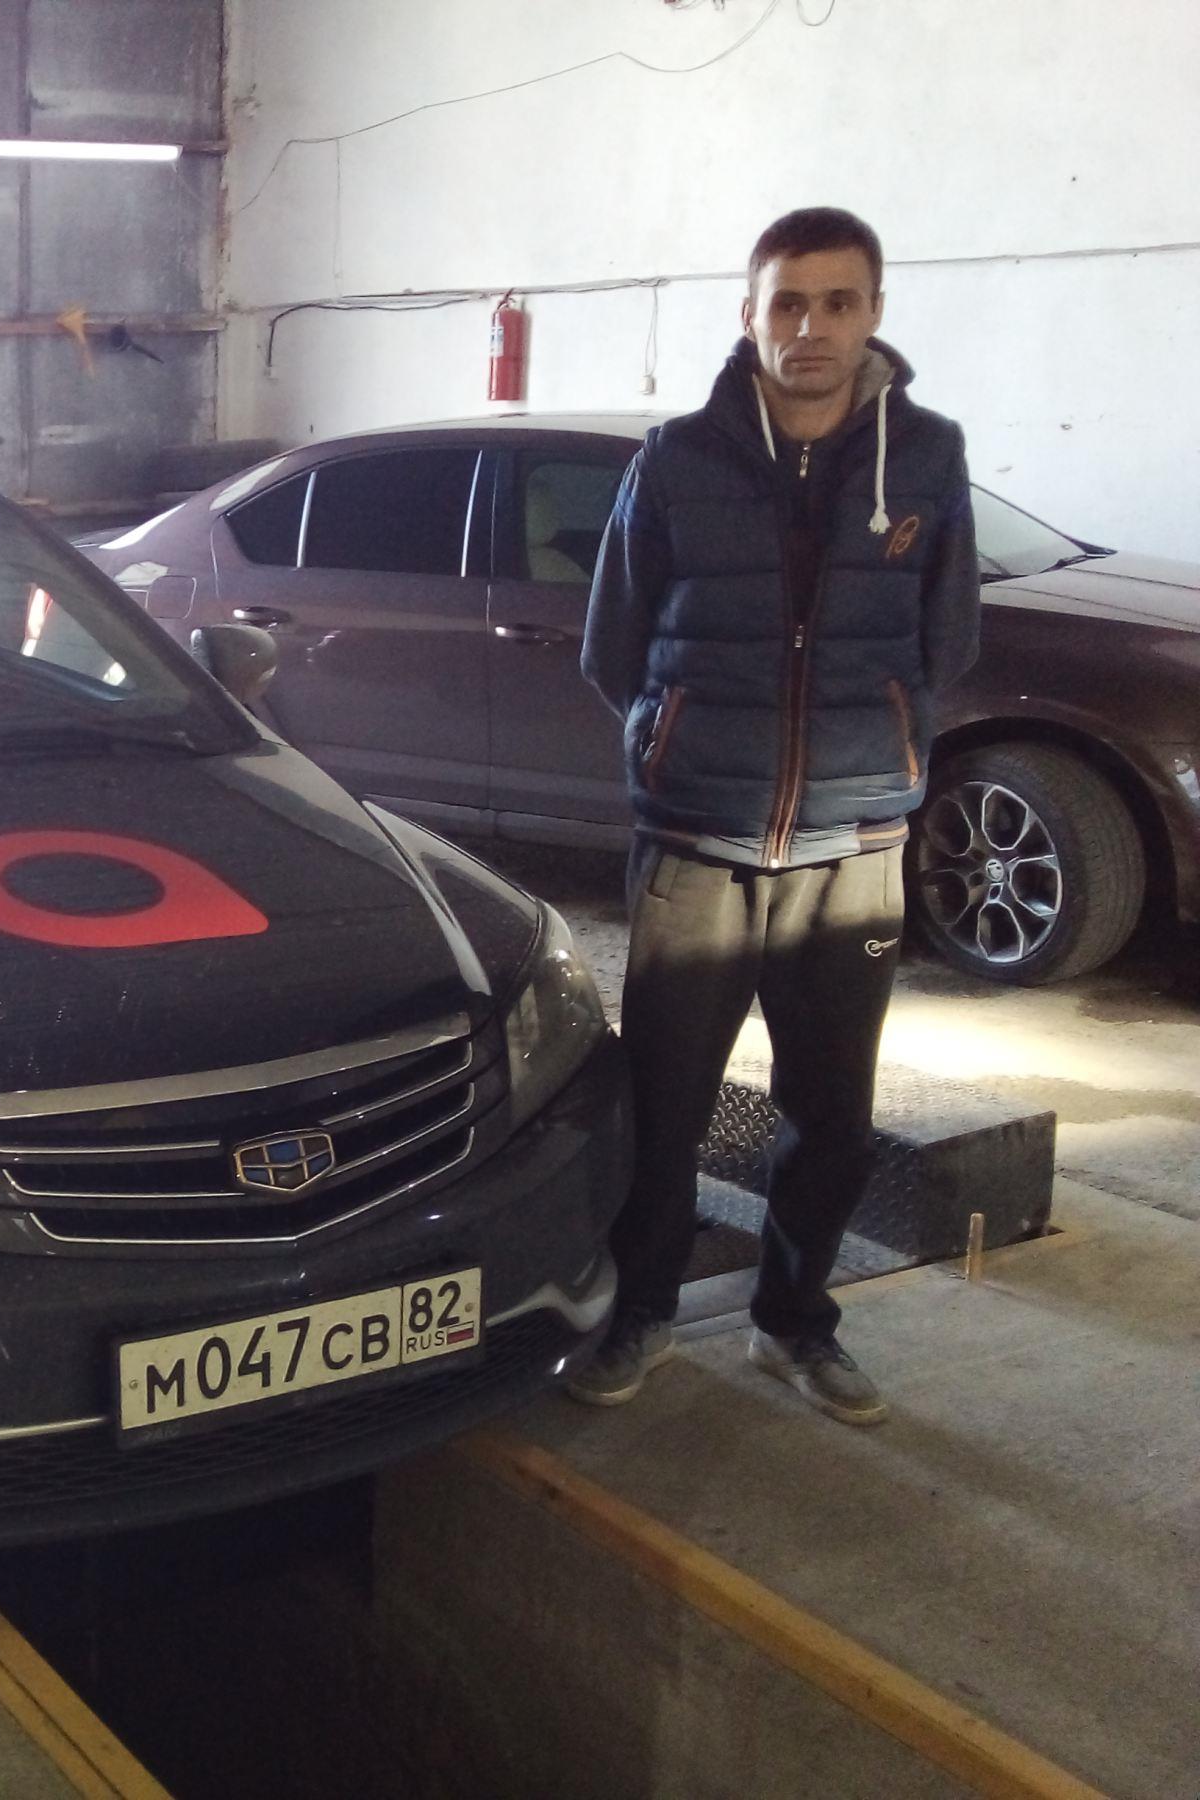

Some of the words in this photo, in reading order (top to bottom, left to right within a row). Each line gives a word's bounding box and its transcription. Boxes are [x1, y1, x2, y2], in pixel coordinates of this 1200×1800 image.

[146, 1314, 391, 1414] M047CB
[408, 1281, 461, 1333] 82
[405, 1332, 445, 1354] RUS
